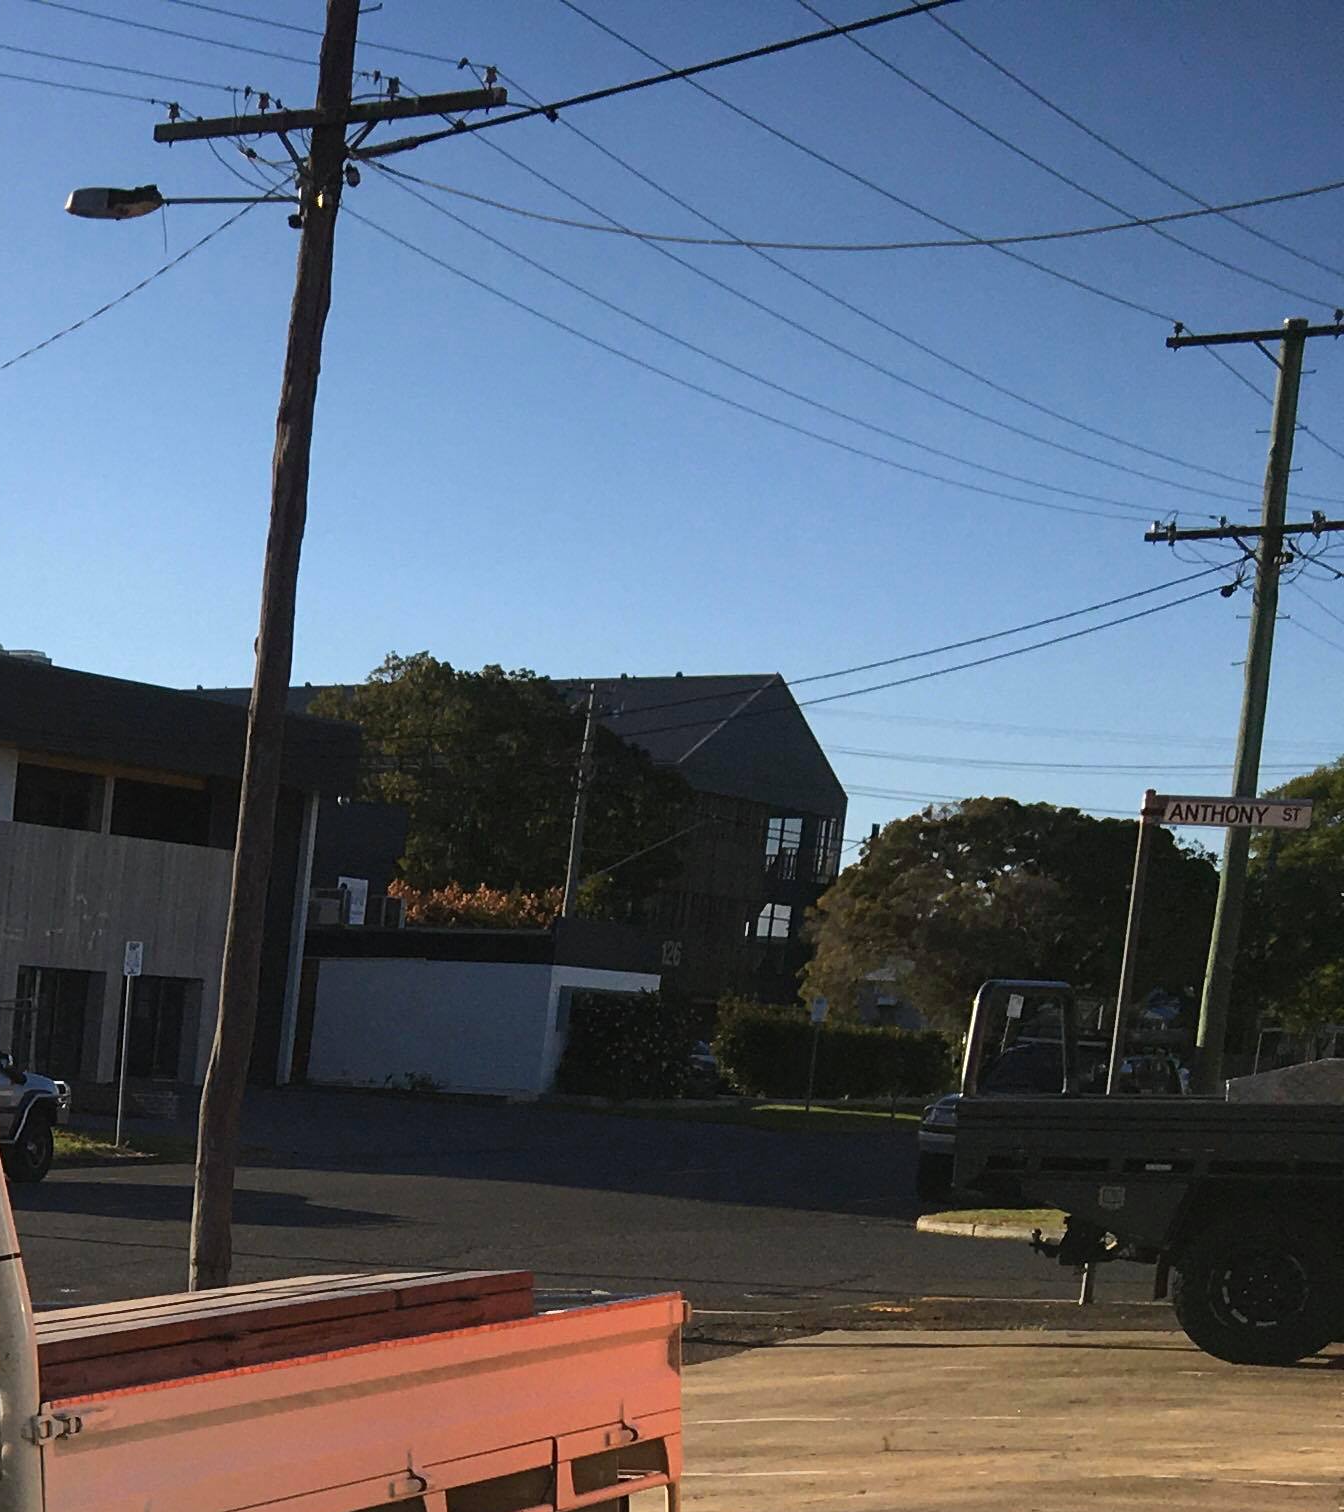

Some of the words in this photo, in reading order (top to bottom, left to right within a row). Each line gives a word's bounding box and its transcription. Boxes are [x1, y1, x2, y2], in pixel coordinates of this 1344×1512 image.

[1168, 802, 1271, 825] ANTHONY
[1282, 807, 1302, 822] ST
[661, 940, 683, 966] 126
